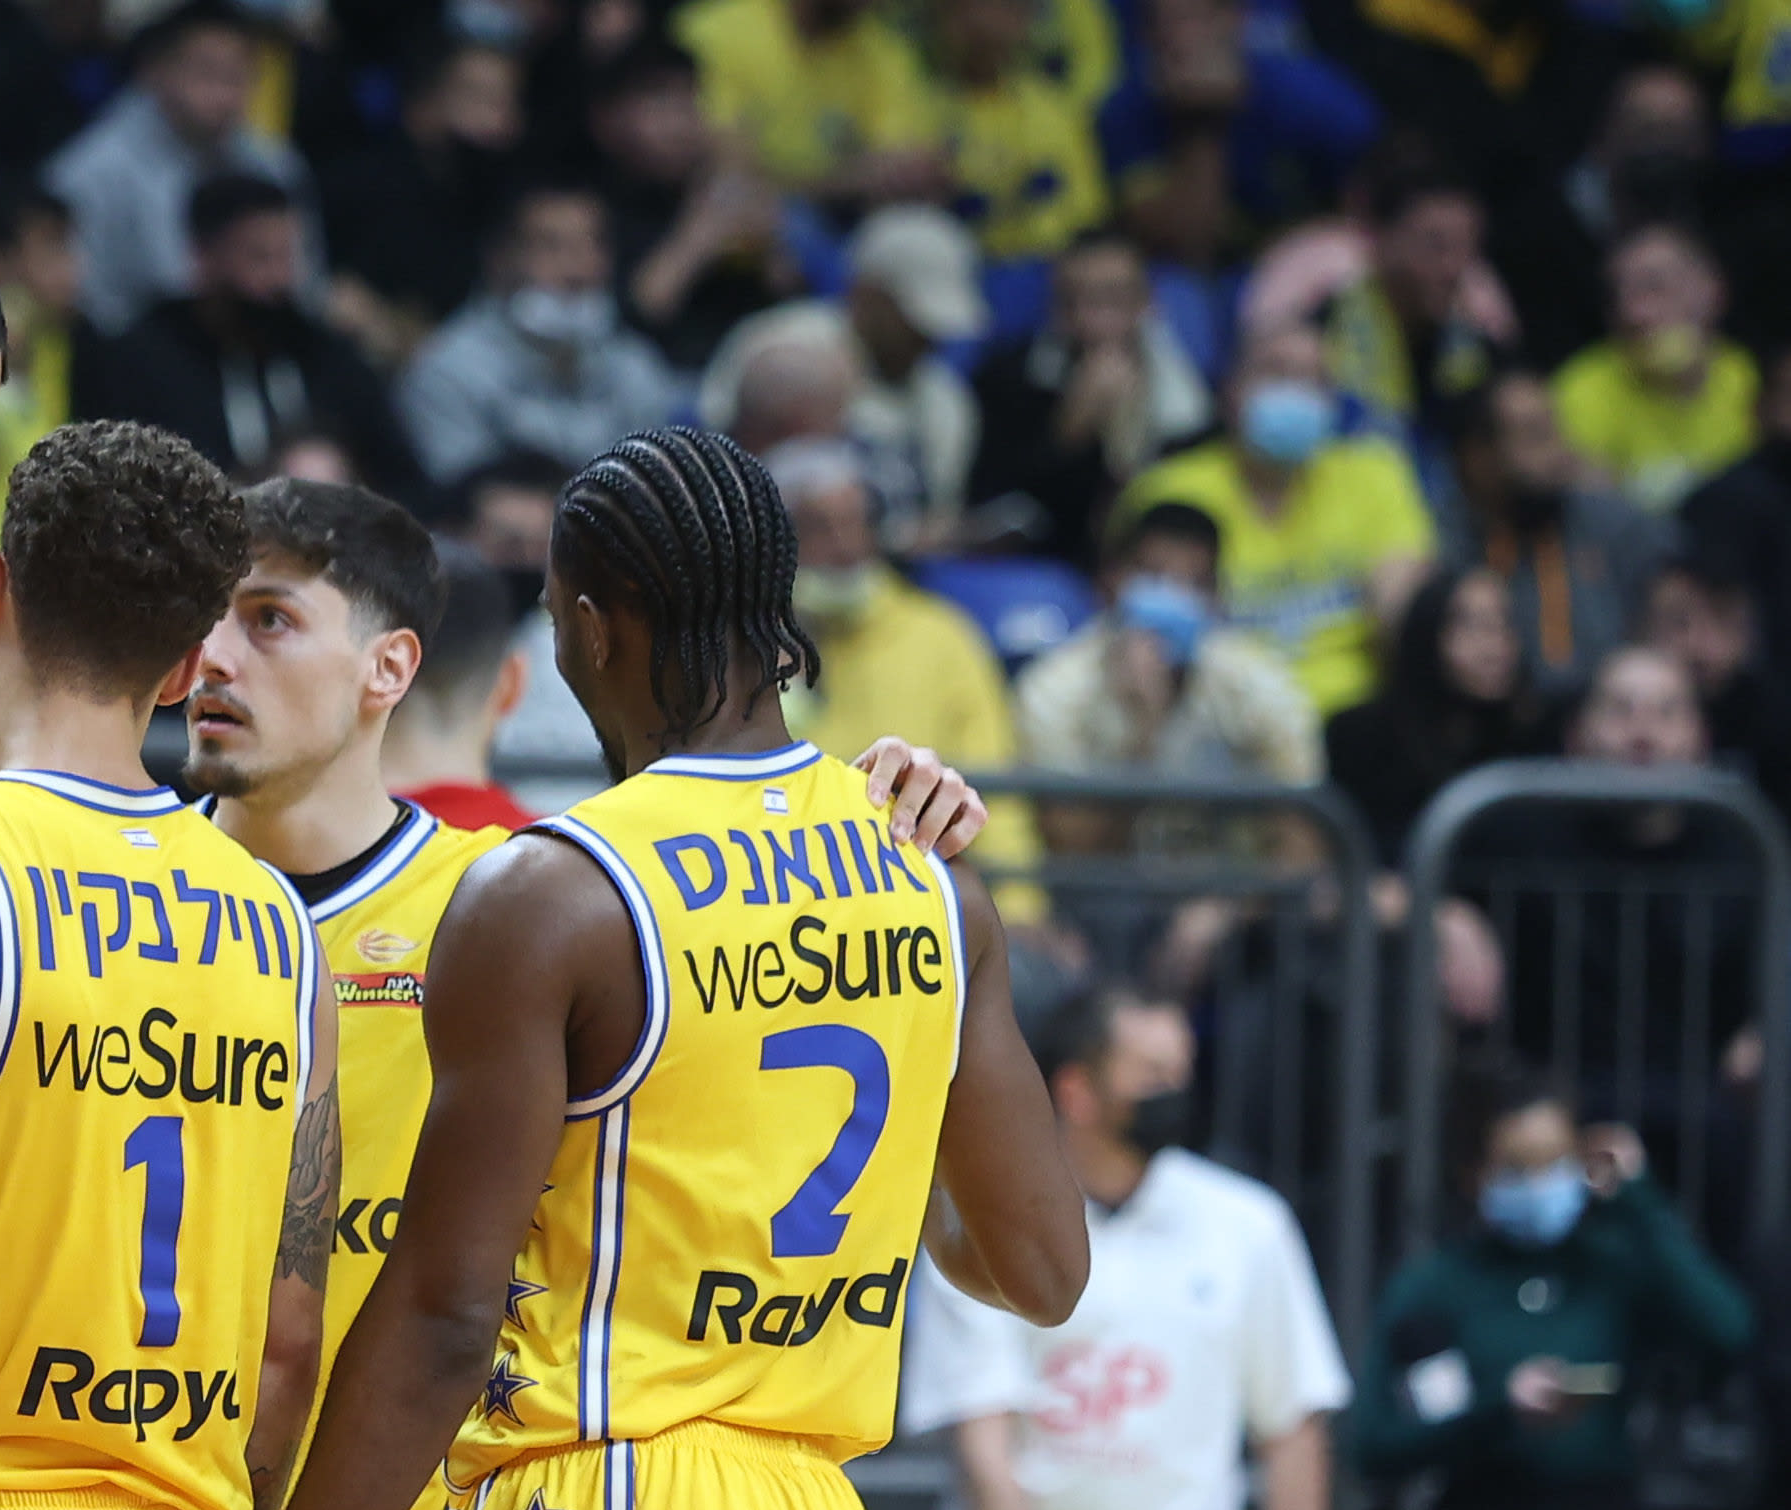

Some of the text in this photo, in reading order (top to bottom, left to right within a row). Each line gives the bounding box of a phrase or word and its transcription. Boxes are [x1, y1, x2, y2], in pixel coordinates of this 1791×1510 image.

[24, 865, 293, 980] ווילבקין
[683, 914, 943, 1014] weSure
[333, 981, 415, 1002] Winner
[33, 1007, 288, 1112] weSure
[759, 1023, 891, 1258] 2
[123, 1115, 183, 1347] 1
